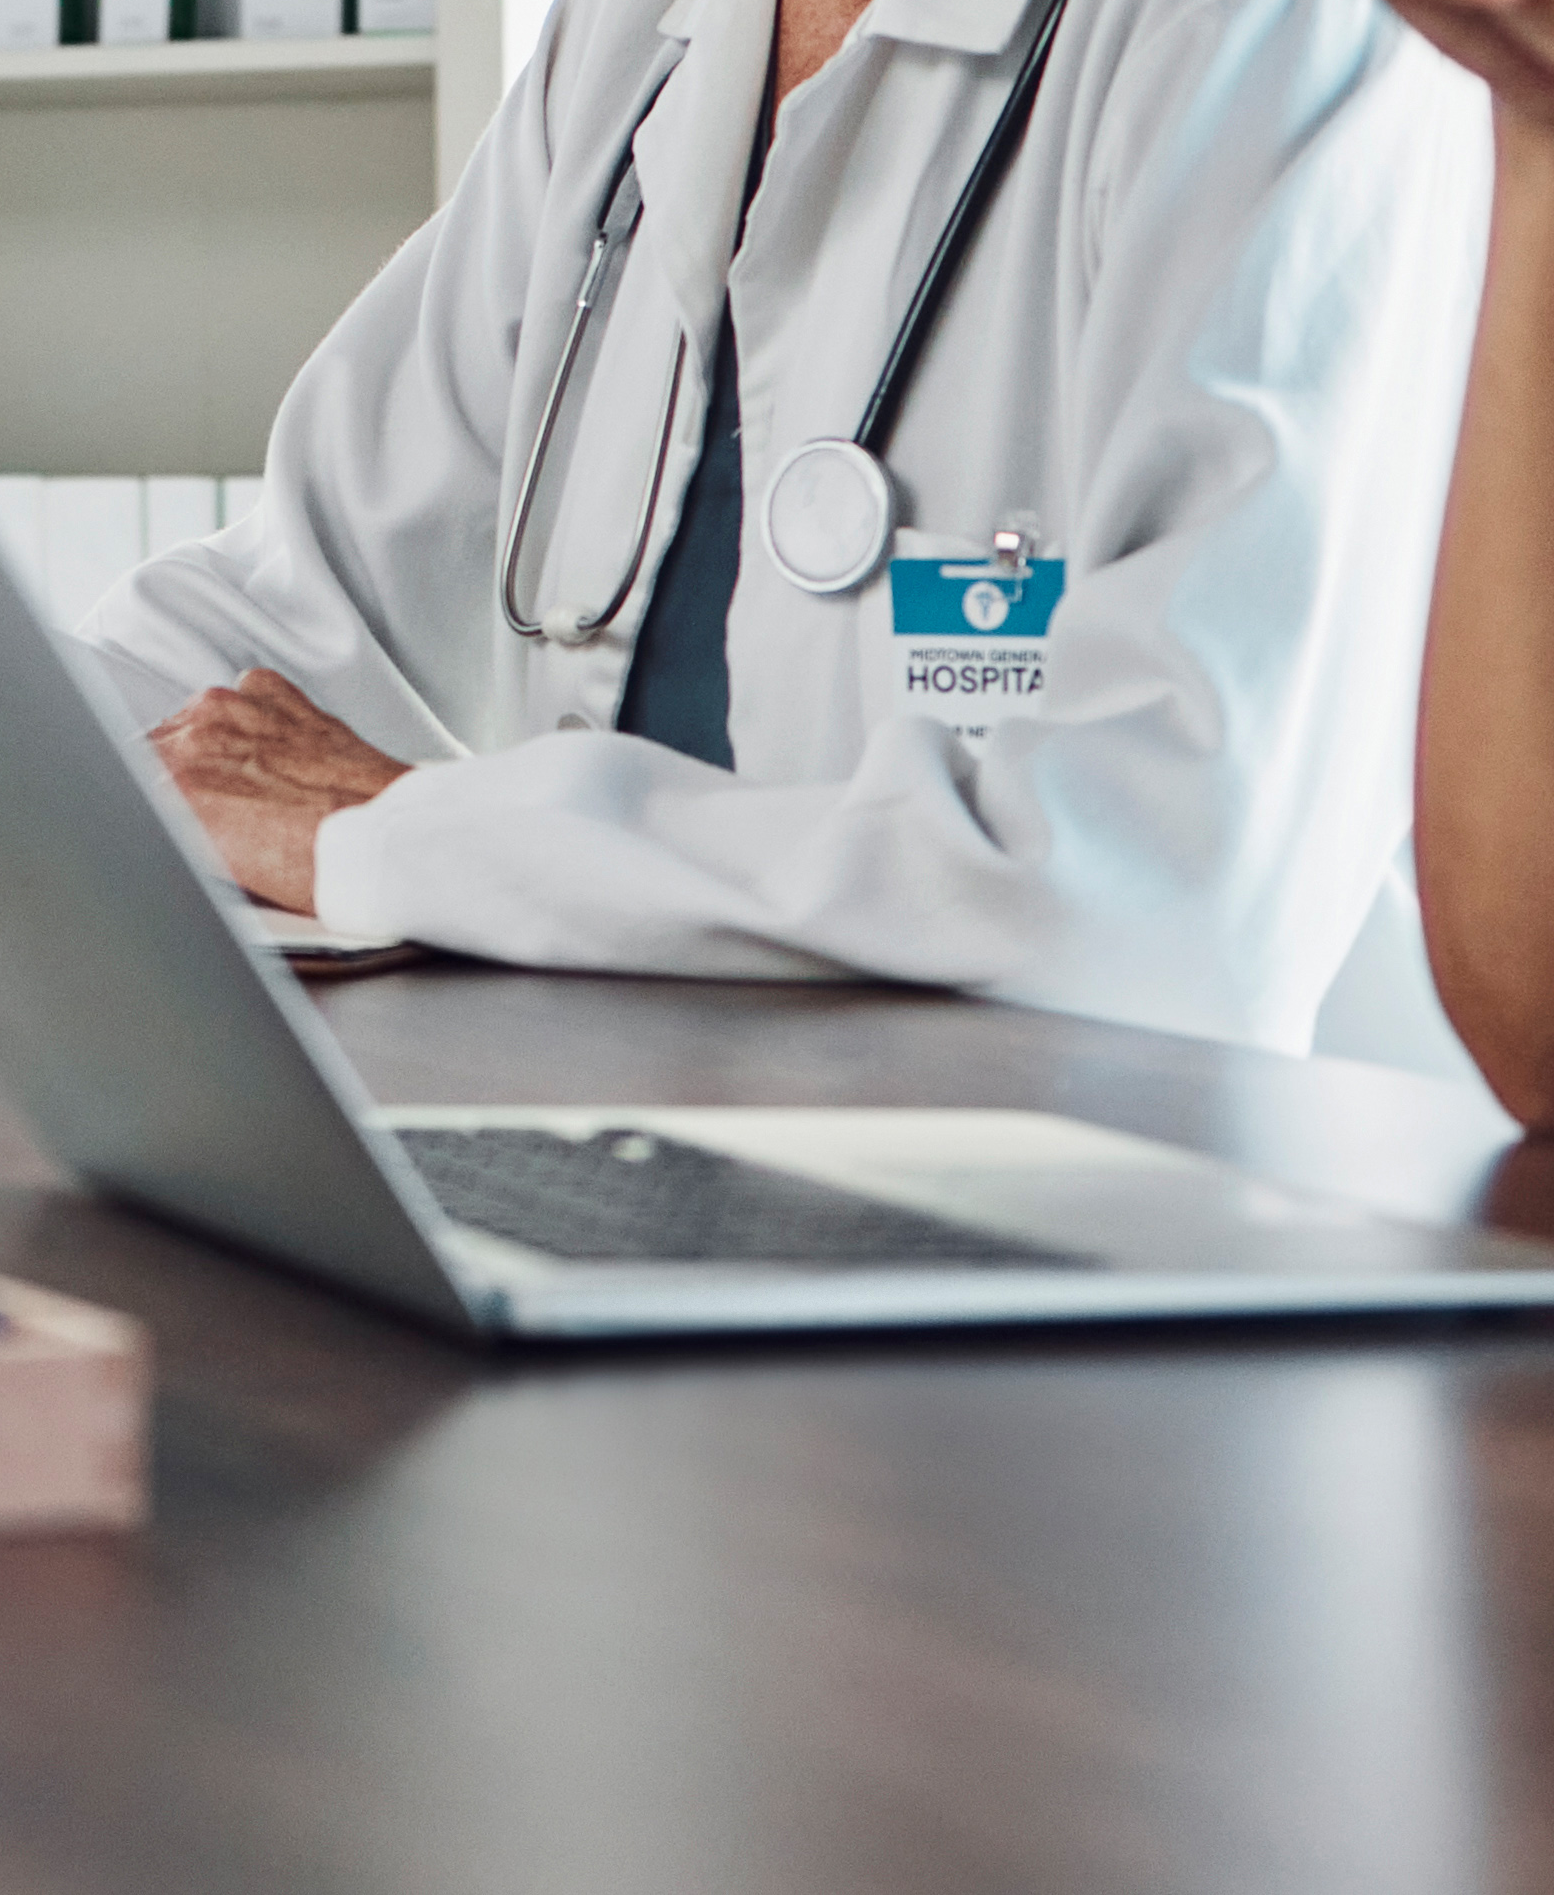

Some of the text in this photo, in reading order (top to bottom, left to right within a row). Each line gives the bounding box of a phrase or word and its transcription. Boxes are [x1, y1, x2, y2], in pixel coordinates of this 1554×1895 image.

[909, 648, 1047, 663] MIDTOWN GENER
[907, 665, 1044, 694] HOSPITA
